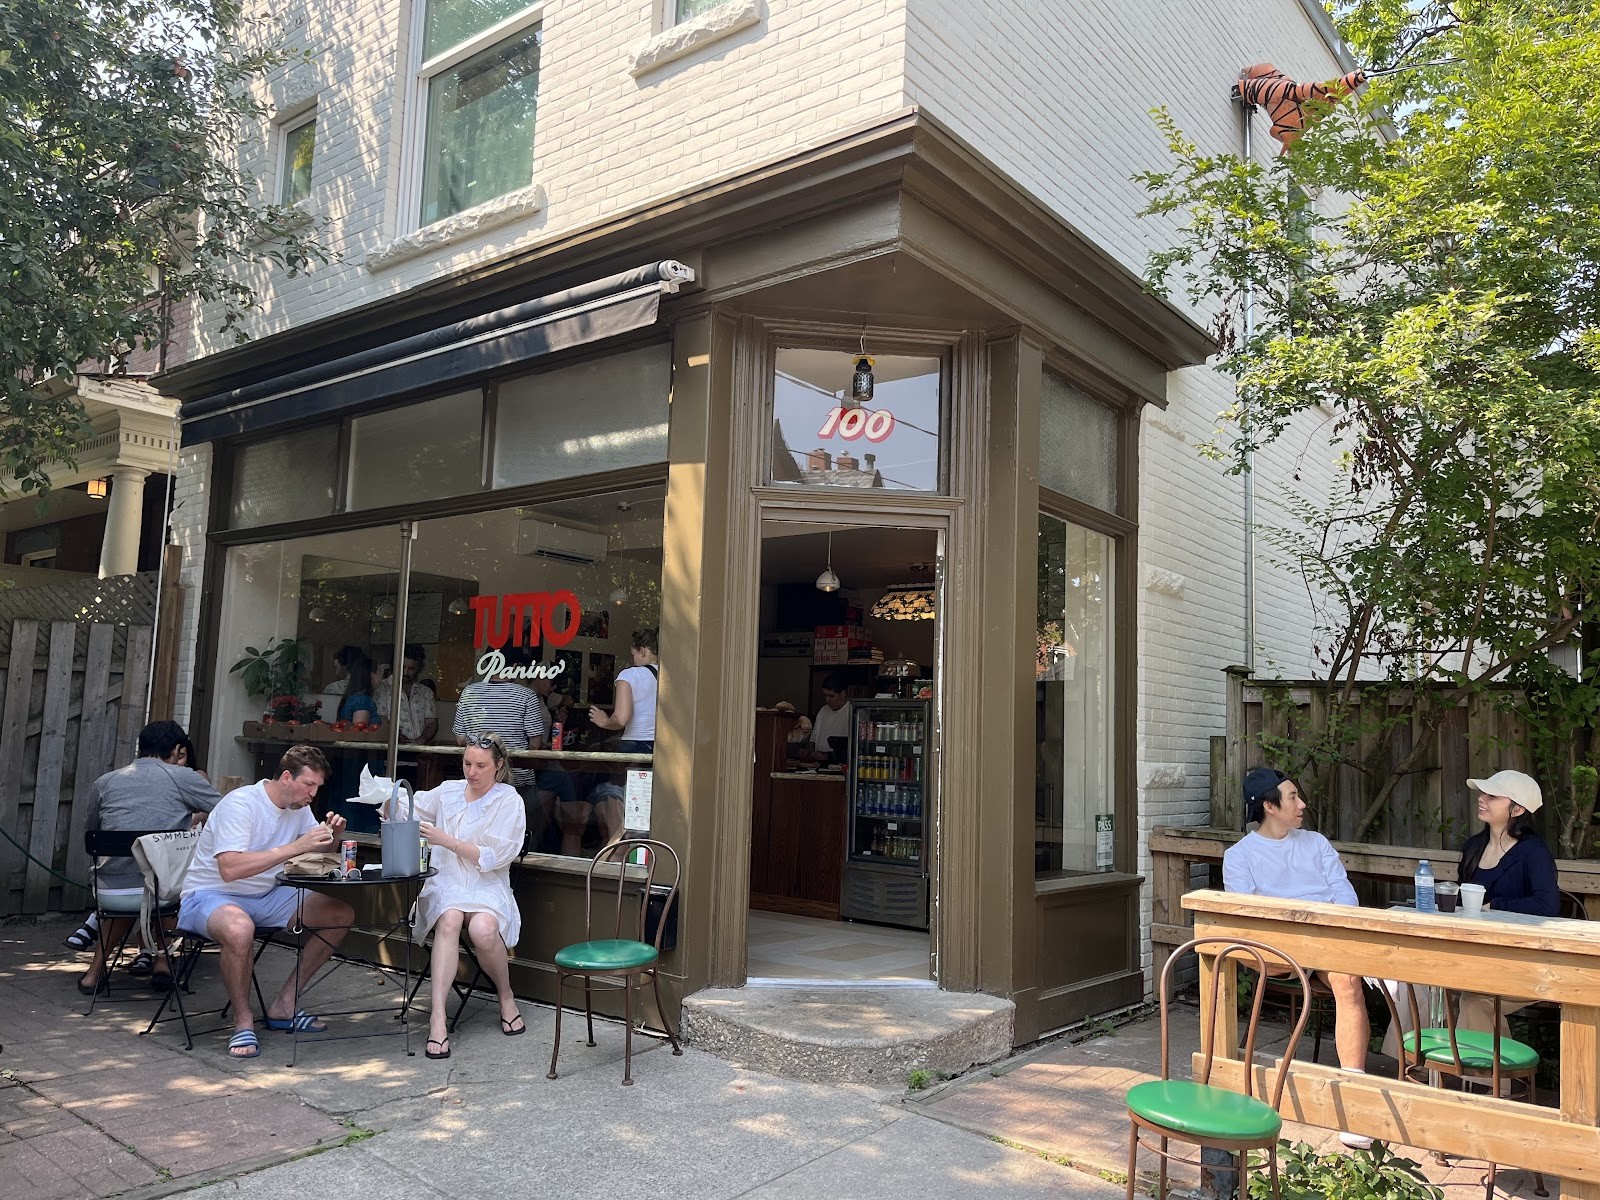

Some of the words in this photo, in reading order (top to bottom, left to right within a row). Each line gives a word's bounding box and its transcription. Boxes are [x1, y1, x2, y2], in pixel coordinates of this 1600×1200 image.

[817, 406, 896, 443] 100
[469, 589, 582, 650] TUTTO
[476, 649, 566, 683] Panino
[1098, 820, 1112, 831] PASS
